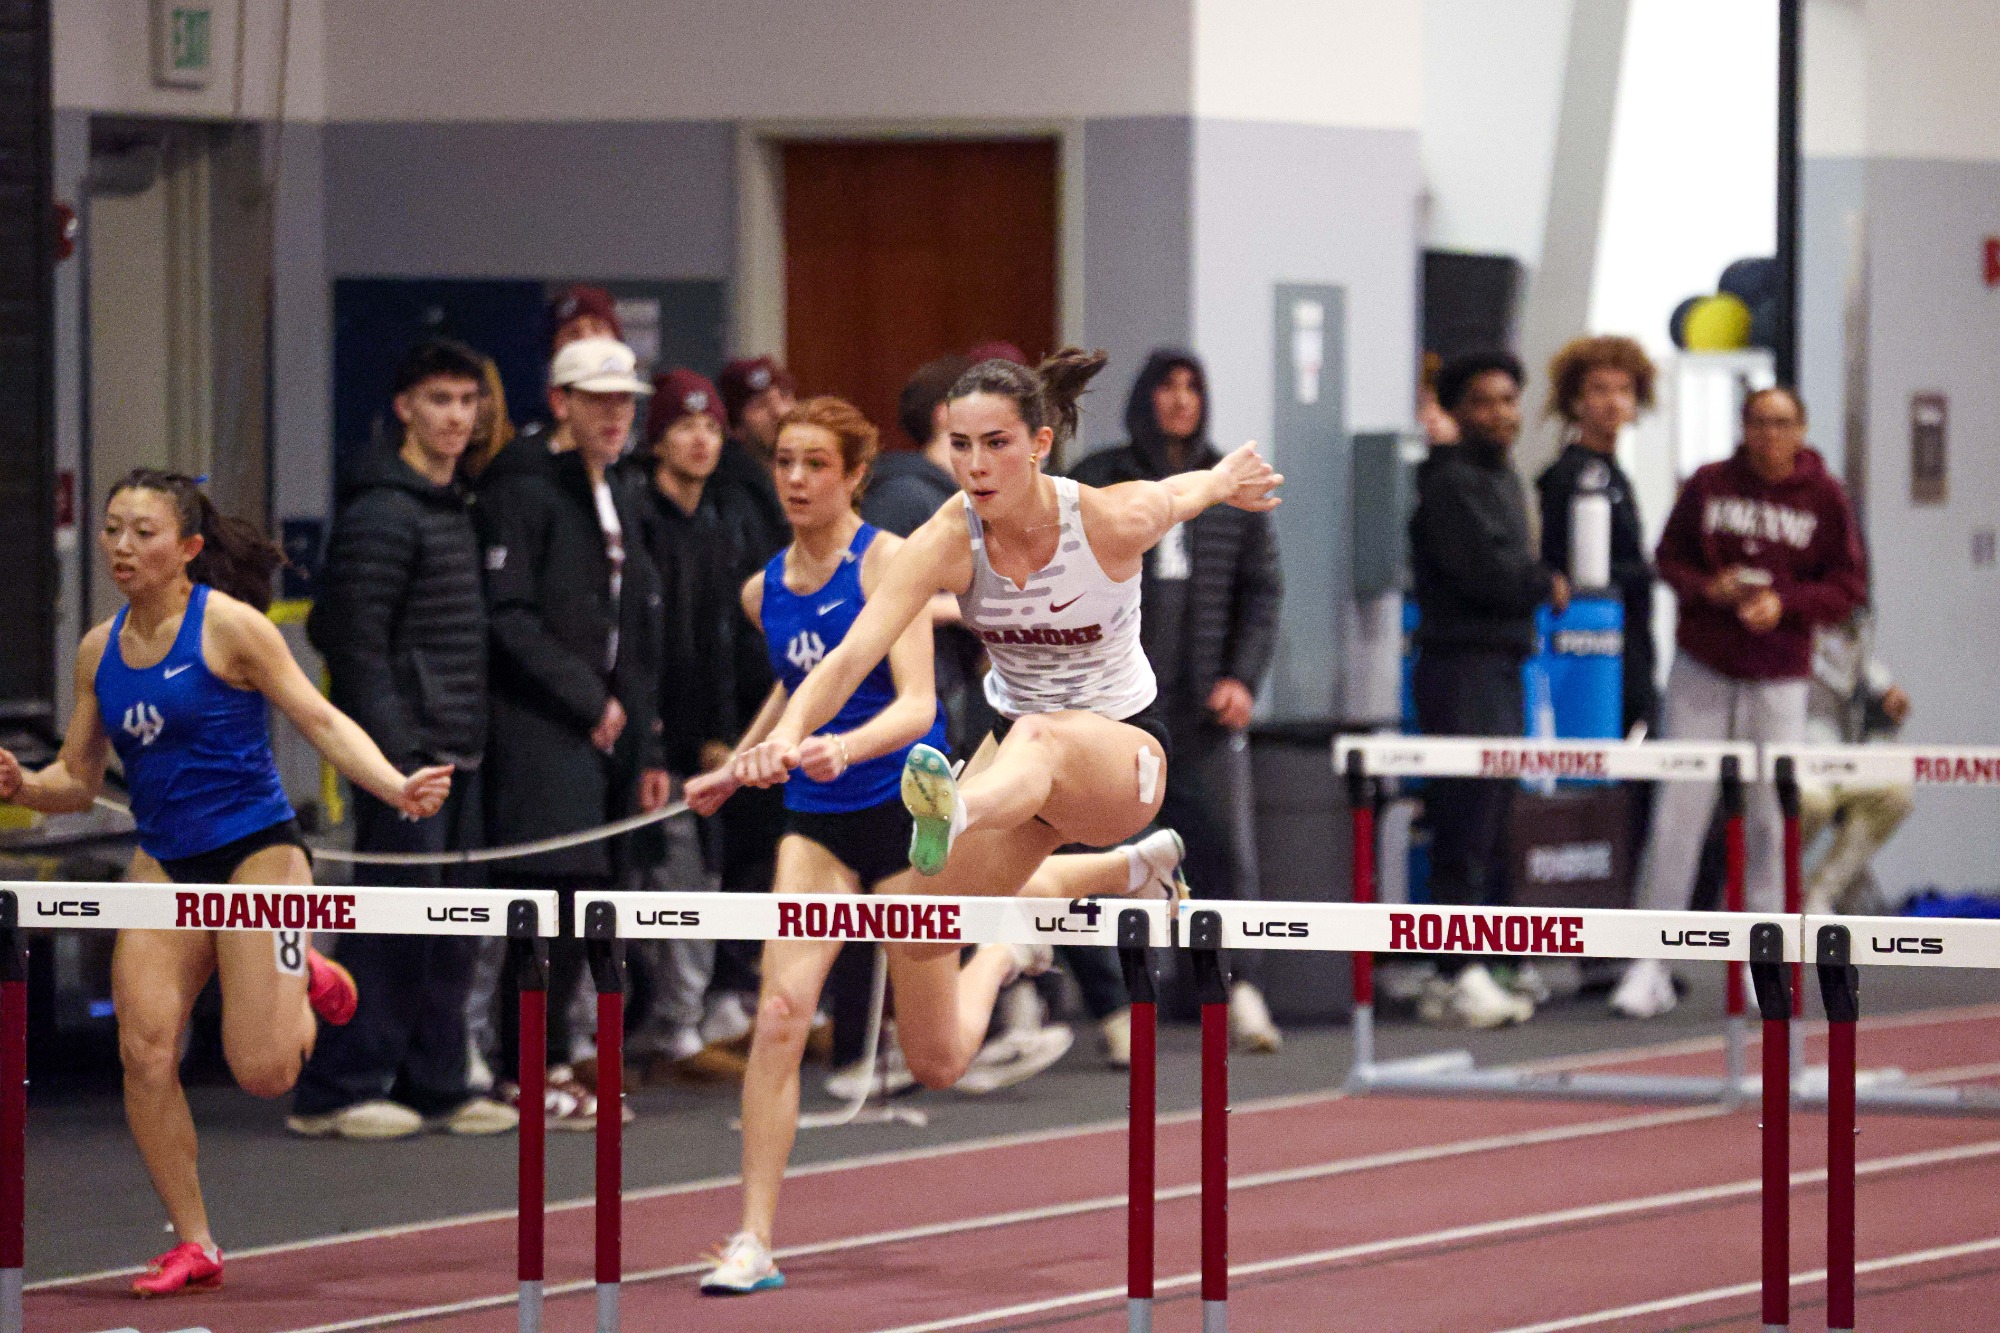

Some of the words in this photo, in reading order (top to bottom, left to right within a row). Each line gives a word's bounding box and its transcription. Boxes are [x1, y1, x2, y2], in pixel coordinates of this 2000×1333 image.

[1481, 750, 1608, 777] ROANOKE
[1914, 757, 2000, 784] ROAN
[36, 900, 101, 917] UCS
[175, 891, 356, 930] ROANOKE
[427, 906, 490, 923] UCS
[636, 910, 700, 926] UCS
[777, 902, 961, 940] ROANOKE
[1242, 921, 1309, 938] UCS
[1389, 913, 1585, 954] ROANOKE
[1661, 930, 1731, 948] UCS
[279, 931, 302, 970] 8
[1872, 936, 1944, 955] UCS
